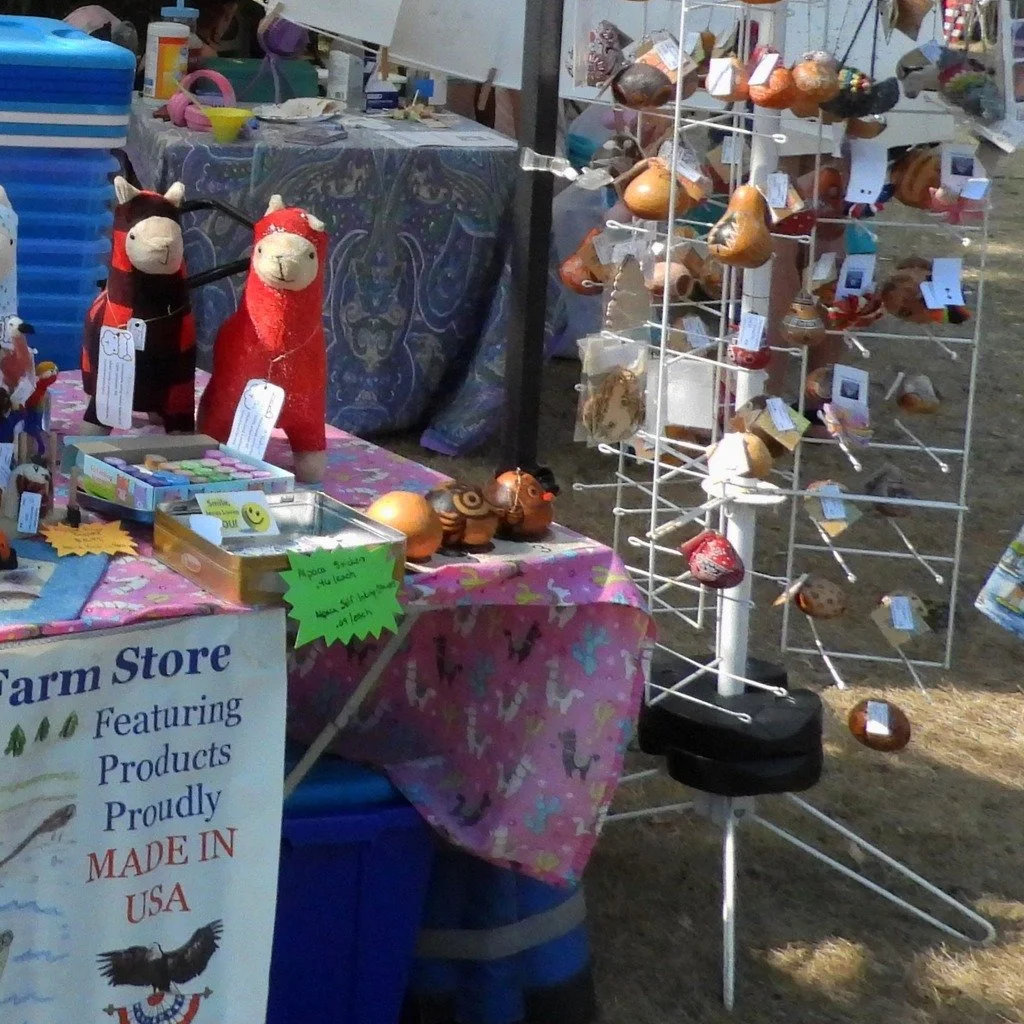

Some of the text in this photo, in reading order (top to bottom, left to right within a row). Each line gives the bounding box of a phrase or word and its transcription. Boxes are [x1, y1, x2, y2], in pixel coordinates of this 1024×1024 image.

[222, 519, 239, 529] OU!
[111, 642, 232, 685] Store
[92, 694, 244, 740] Featuring
[97, 742, 232, 786] Products
[102, 782, 223, 832] Proudly
[85, 826, 238, 884] MADE IN
[125, 882, 192, 924] USA
